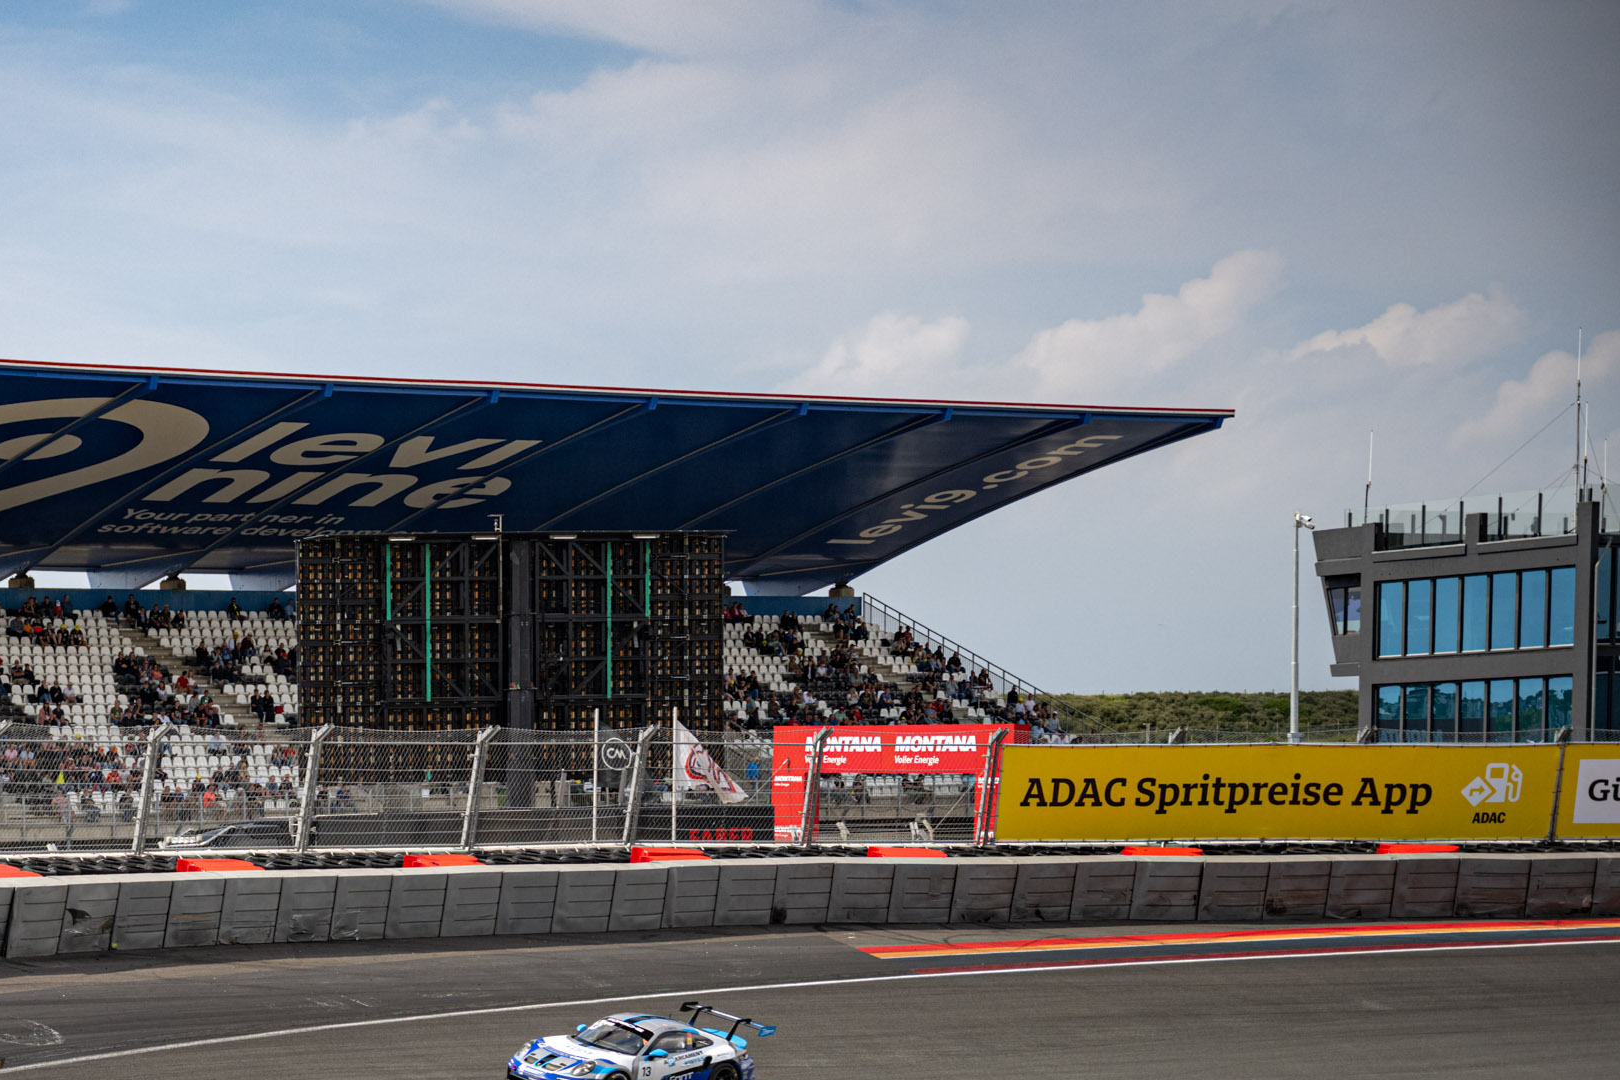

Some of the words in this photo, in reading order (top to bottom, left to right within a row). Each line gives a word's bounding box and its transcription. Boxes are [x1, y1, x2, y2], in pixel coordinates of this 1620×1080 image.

[208, 421, 544, 470] levi
[142, 468, 512, 508] nine
[122, 508, 187, 522] Your
[187, 510, 314, 527] partner
[314, 513, 346, 525] in
[96, 523, 234, 536] software
[894, 735, 977, 752] MONTANA
[823, 755, 847, 766] Energie
[894, 755, 913, 764] Voller
[913, 755, 940, 767] Energie
[1020, 777, 1127, 808] ADAC
[1133, 773, 1344, 815] Spritpreise
[1351, 777, 1434, 815] App
[1472, 812, 1507, 825] ADAC
[641, 1066, 652, 1078] 13
